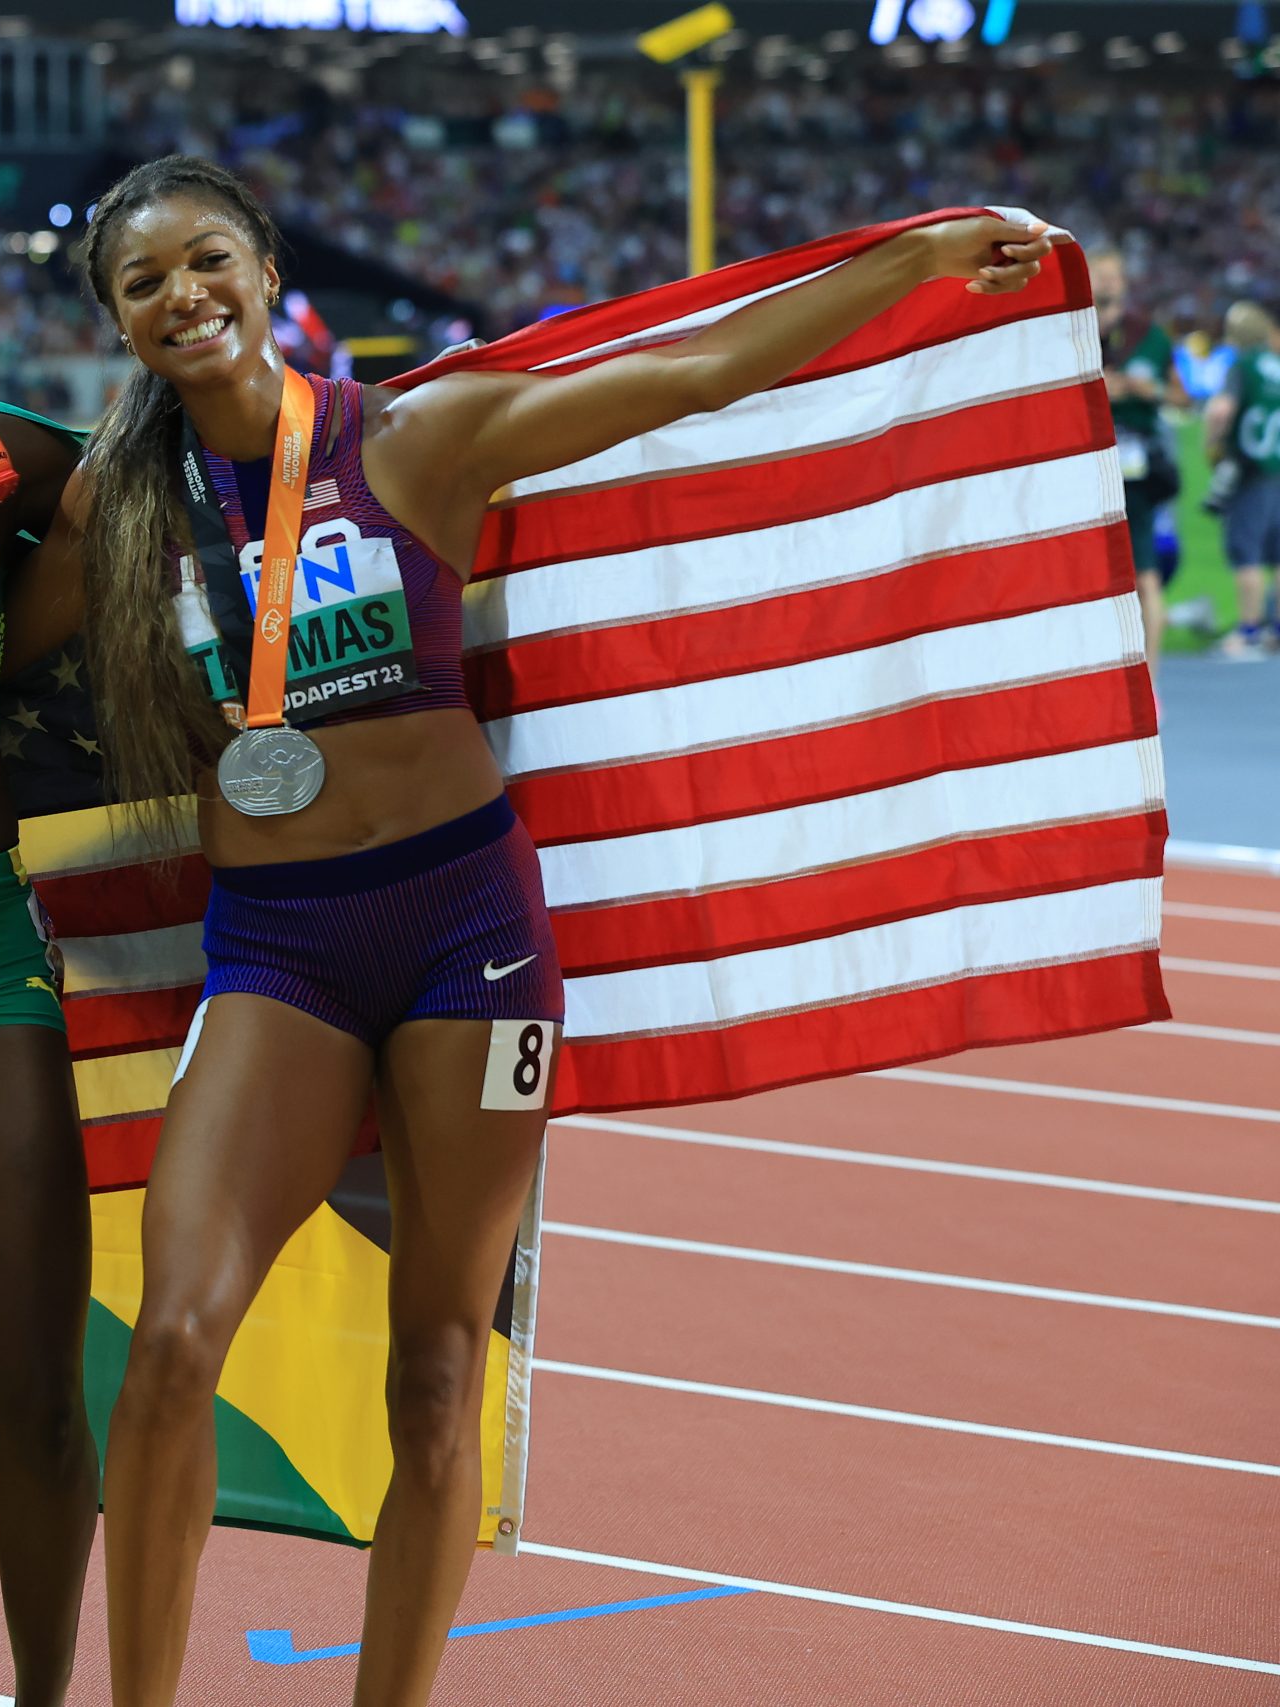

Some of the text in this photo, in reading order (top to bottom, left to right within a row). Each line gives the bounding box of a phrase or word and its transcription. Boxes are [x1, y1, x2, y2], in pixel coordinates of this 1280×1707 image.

[186, 450, 206, 494] WONDER
[282, 434, 293, 484] WITNESS
[290, 431, 302, 479] WONDER
[182, 459, 201, 503] WITNESS
[190, 600, 395, 697] TMAS
[513, 1023, 544, 1096] 8
